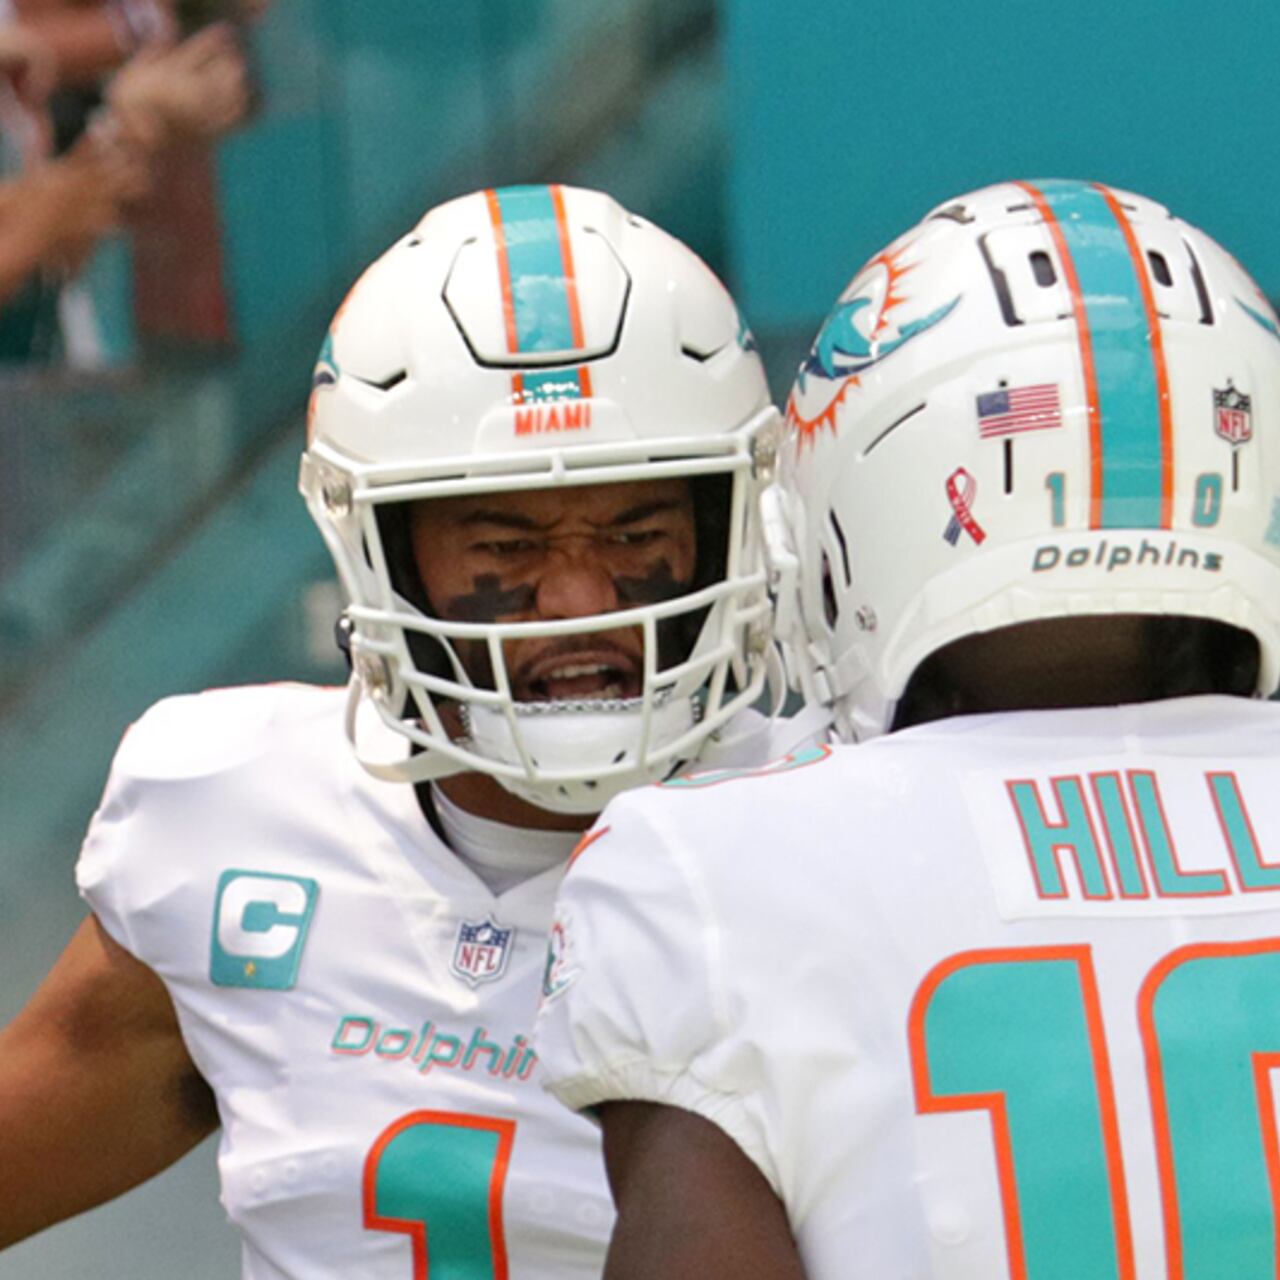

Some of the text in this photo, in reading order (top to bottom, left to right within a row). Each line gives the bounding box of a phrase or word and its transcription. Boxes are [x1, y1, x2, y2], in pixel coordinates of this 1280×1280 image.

[514, 402, 592, 436] MIAMI
[1217, 408, 1252, 440] NFL
[1045, 471, 1224, 528] 1 0
[1031, 538, 1224, 573] Dolphins
[218, 876, 307, 959] C
[459, 943, 497, 974] NFL
